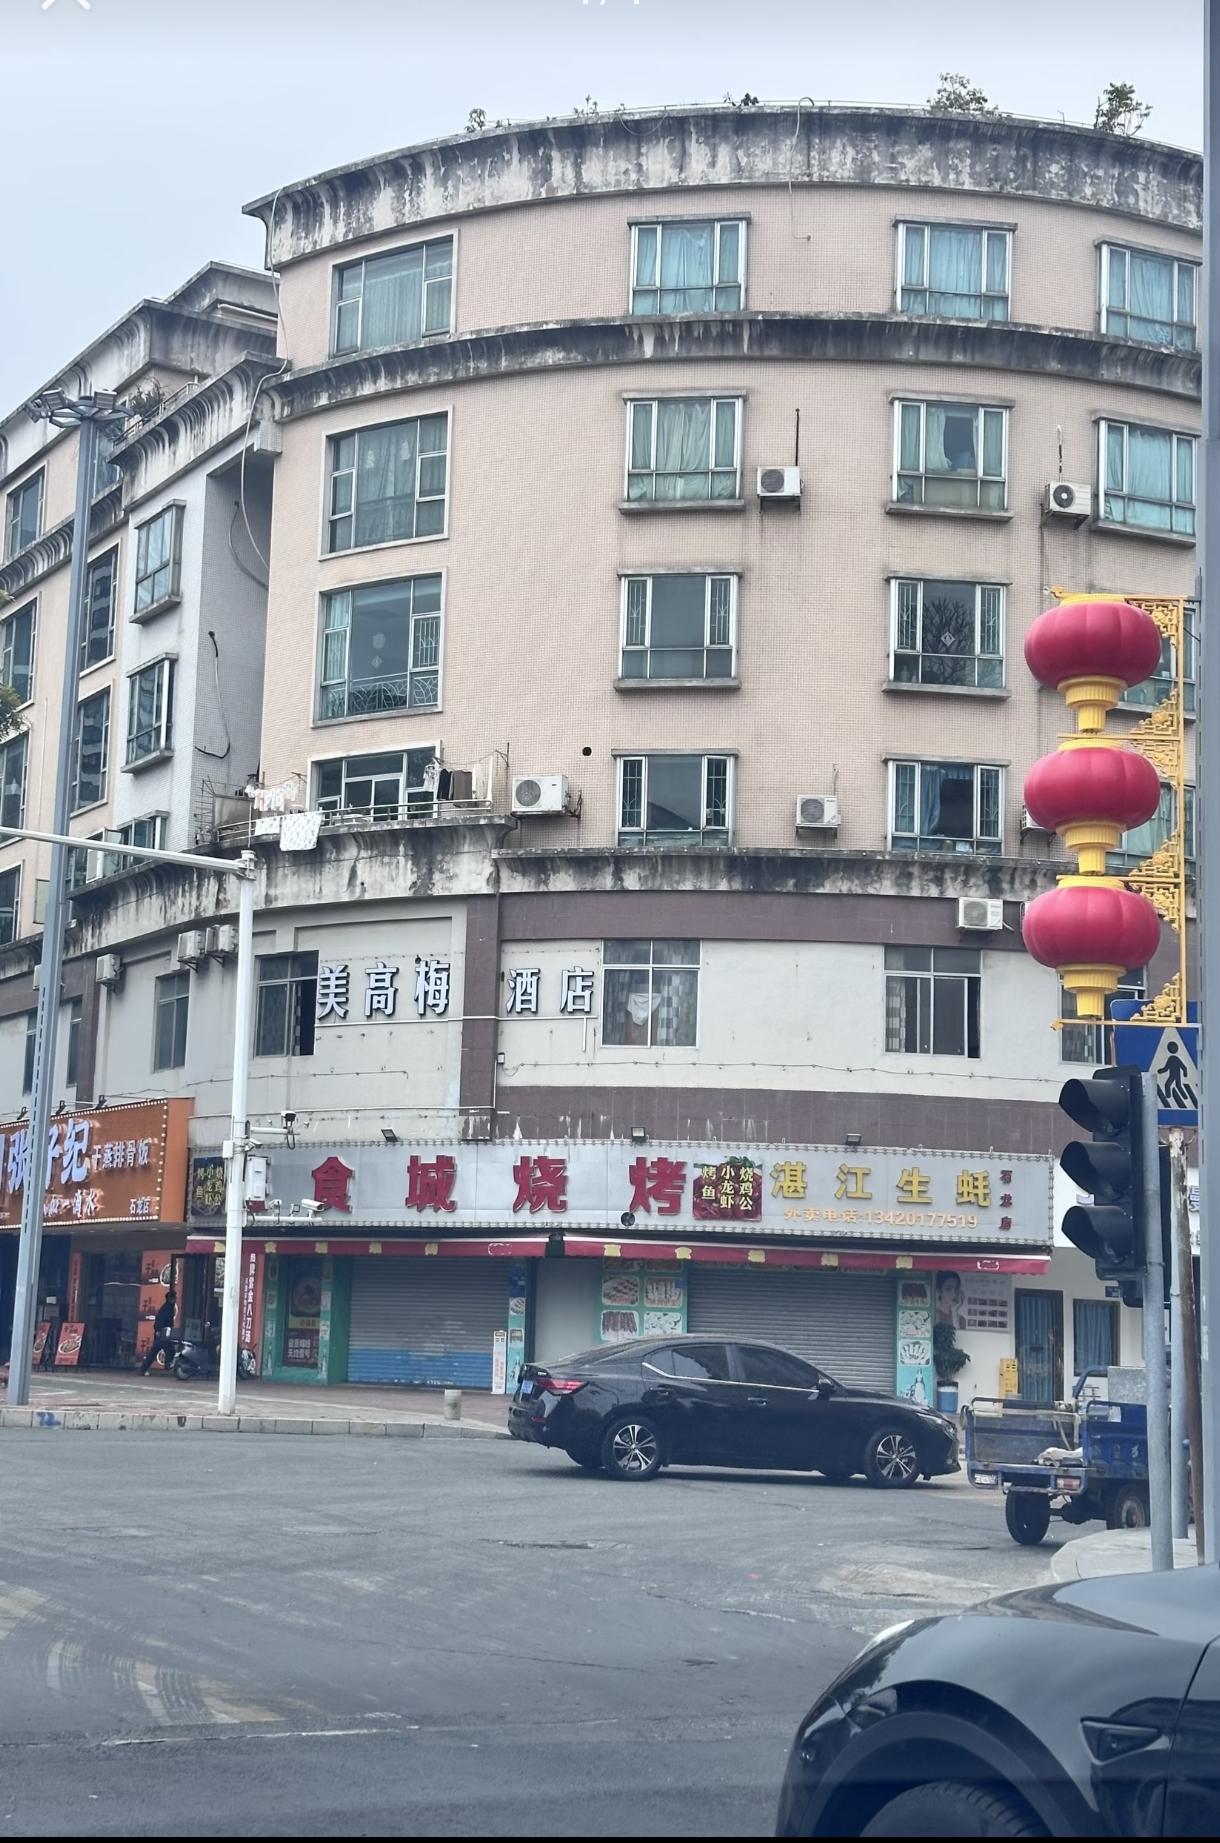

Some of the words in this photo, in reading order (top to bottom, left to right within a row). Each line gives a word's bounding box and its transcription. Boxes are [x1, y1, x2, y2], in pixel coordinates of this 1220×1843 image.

[317, 960, 450, 1019] 美高梅
[506, 966, 594, 1014] 酒店
[311, 1154, 687, 1216] 食城烧烤
[701, 1166, 716, 1200] 烤鱼
[720, 1165, 734, 1209] 小龙虾
[739, 1167, 753, 1210] 烧鸡公
[770, 1161, 992, 1207] 湛江生蚝
